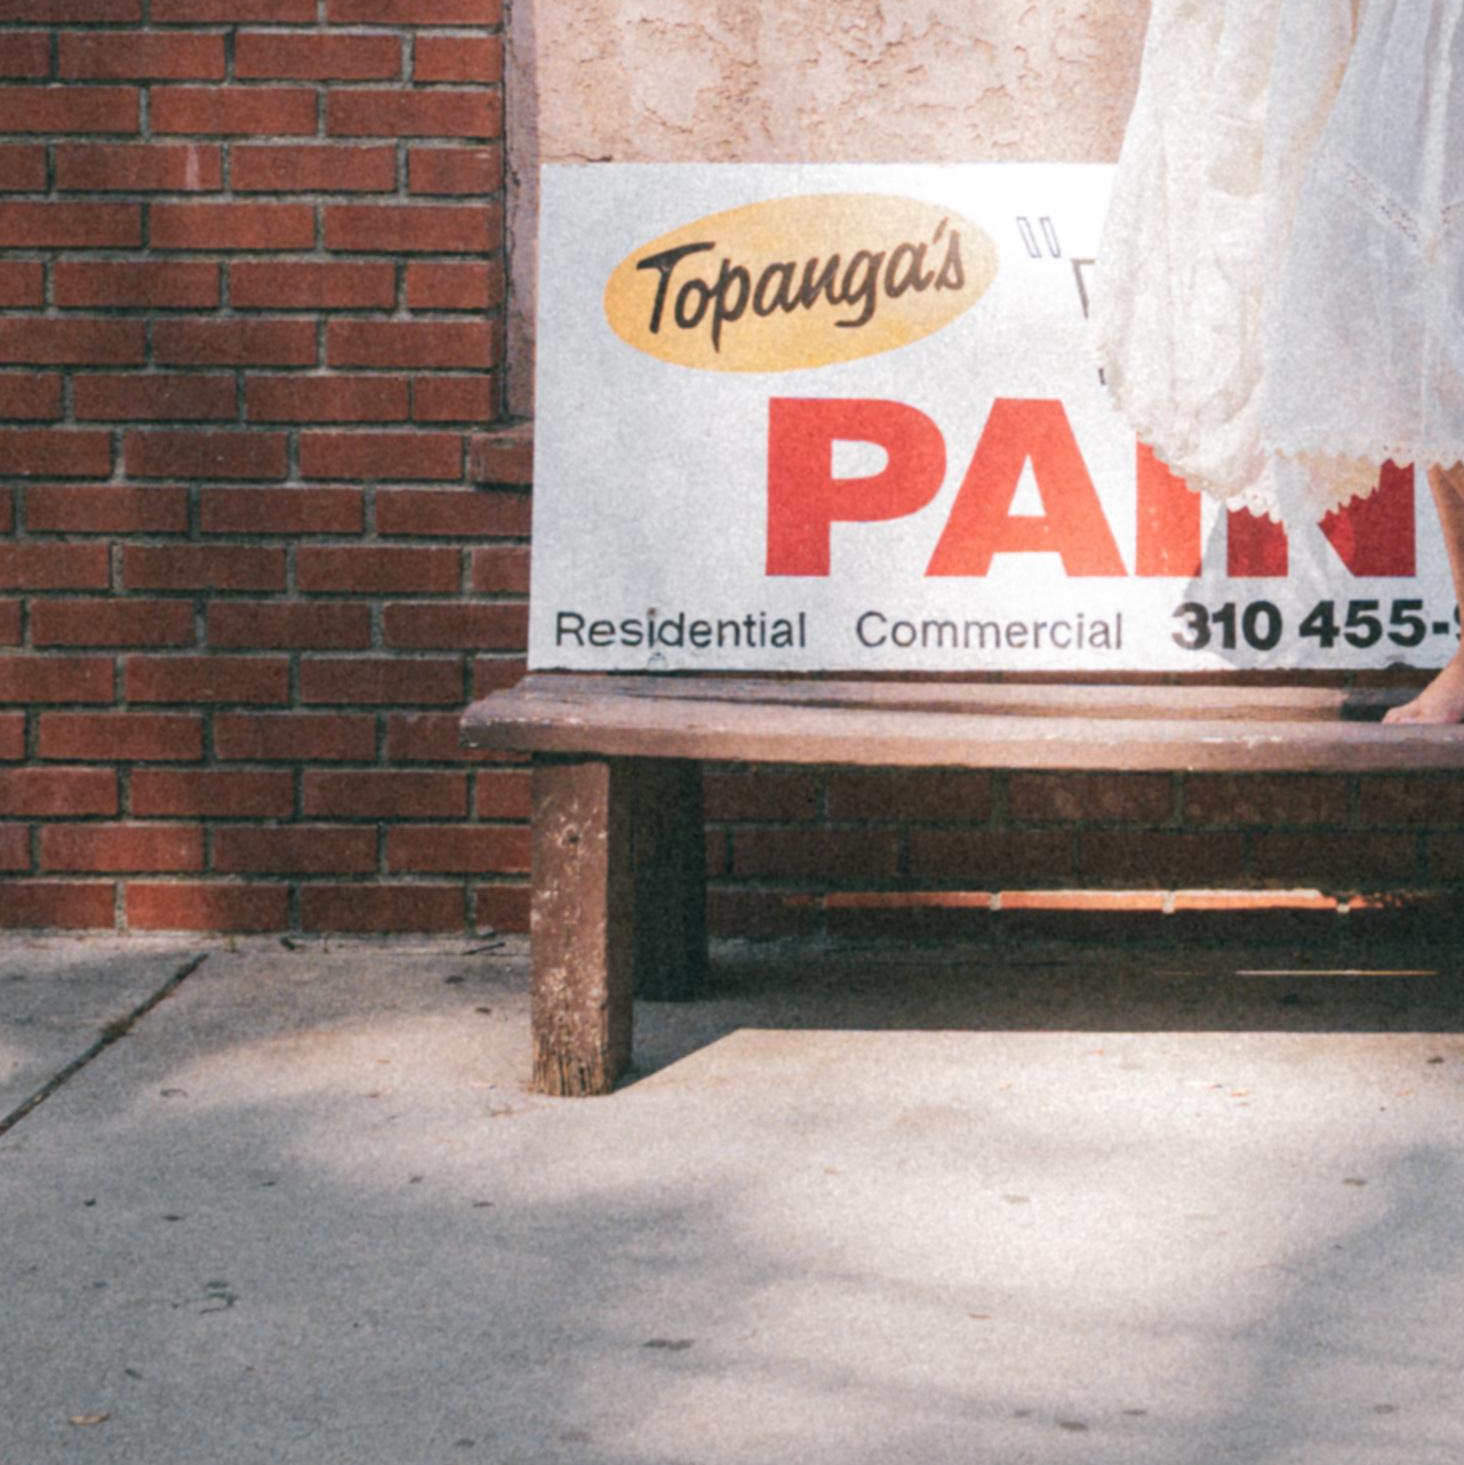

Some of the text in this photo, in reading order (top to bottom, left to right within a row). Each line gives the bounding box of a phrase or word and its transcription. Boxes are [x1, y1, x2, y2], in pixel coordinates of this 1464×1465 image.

[636, 216, 966, 354] Topanga's
[555, 608, 807, 650] Residential
[855, 610, 1123, 650] Commercial
[1172, 599, 1284, 651] 310
